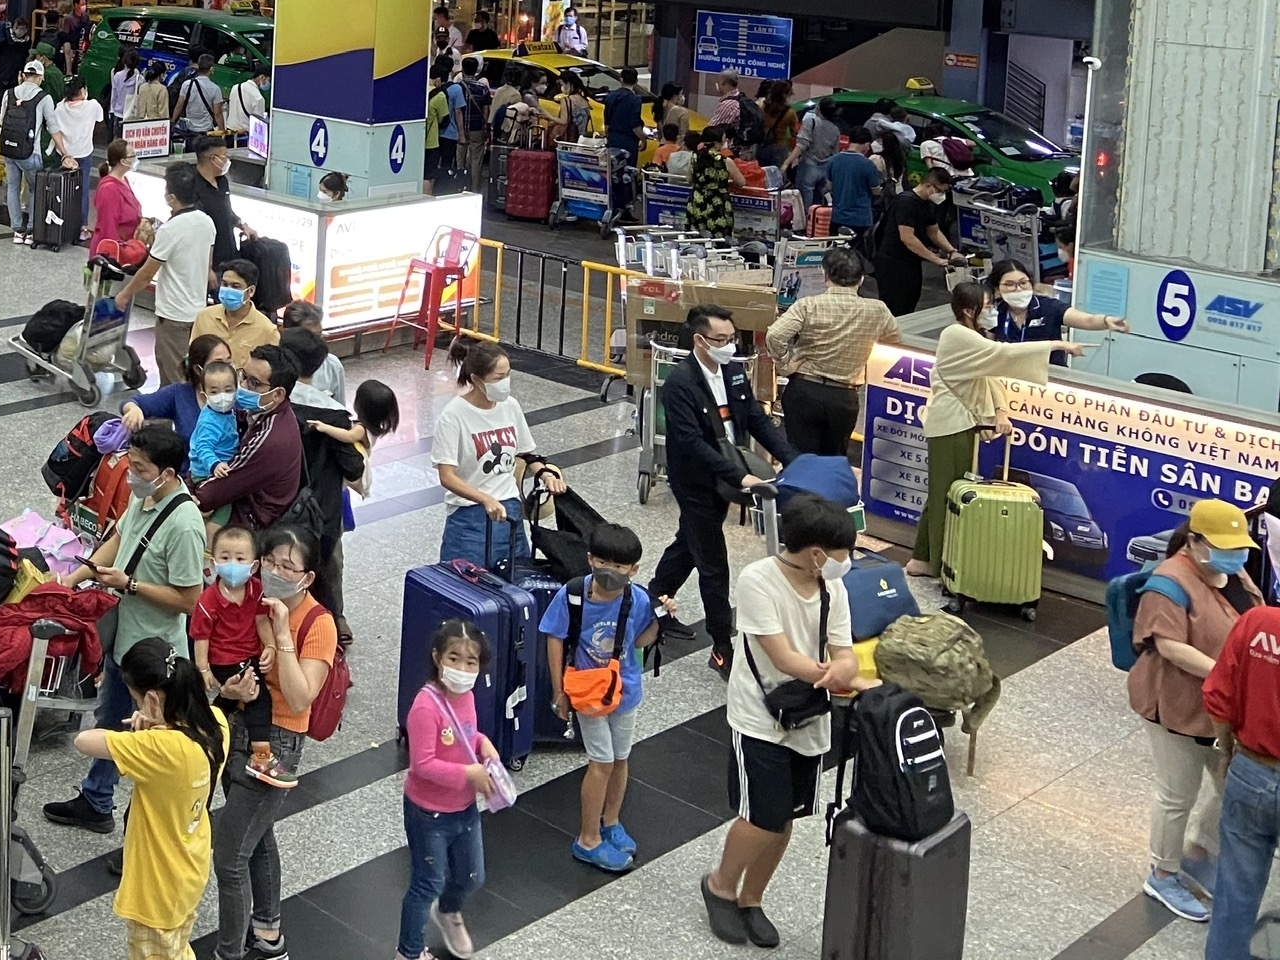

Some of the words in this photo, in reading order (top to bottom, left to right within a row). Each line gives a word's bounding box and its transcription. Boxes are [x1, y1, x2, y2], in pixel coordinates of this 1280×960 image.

[744, 66, 758, 77] D1
[312, 127, 326, 158] 4
[391, 134, 404, 164] 4
[1161, 283, 1191, 328] 5
[1204, 294, 1264, 319] ASV
[1028, 384, 1048, 398] TY
[1215, 426, 1227, 439] &
[877, 424, 888, 433] XE
[1061, 411, 1109, 433] HÀNG
[1116, 424, 1180, 449] KHÔNG
[1187, 439, 1231, 461] VIỆT
[1238, 451, 1280, 472] NAM
[471, 426, 516, 461] MICKEY
[900, 450, 913, 461] XE
[916, 454, 922, 463] 5
[1010, 426, 1068, 458] ĐÓN
[1079, 443, 1149, 478] TIỄN
[1160, 462, 1221, 495] SÂN
[899, 471, 912, 482] XE
[914, 476, 921, 484] 8
[895, 490, 908, 502] XE
[910, 495, 923, 506] 16
[71, 512, 98, 532] HABECO
